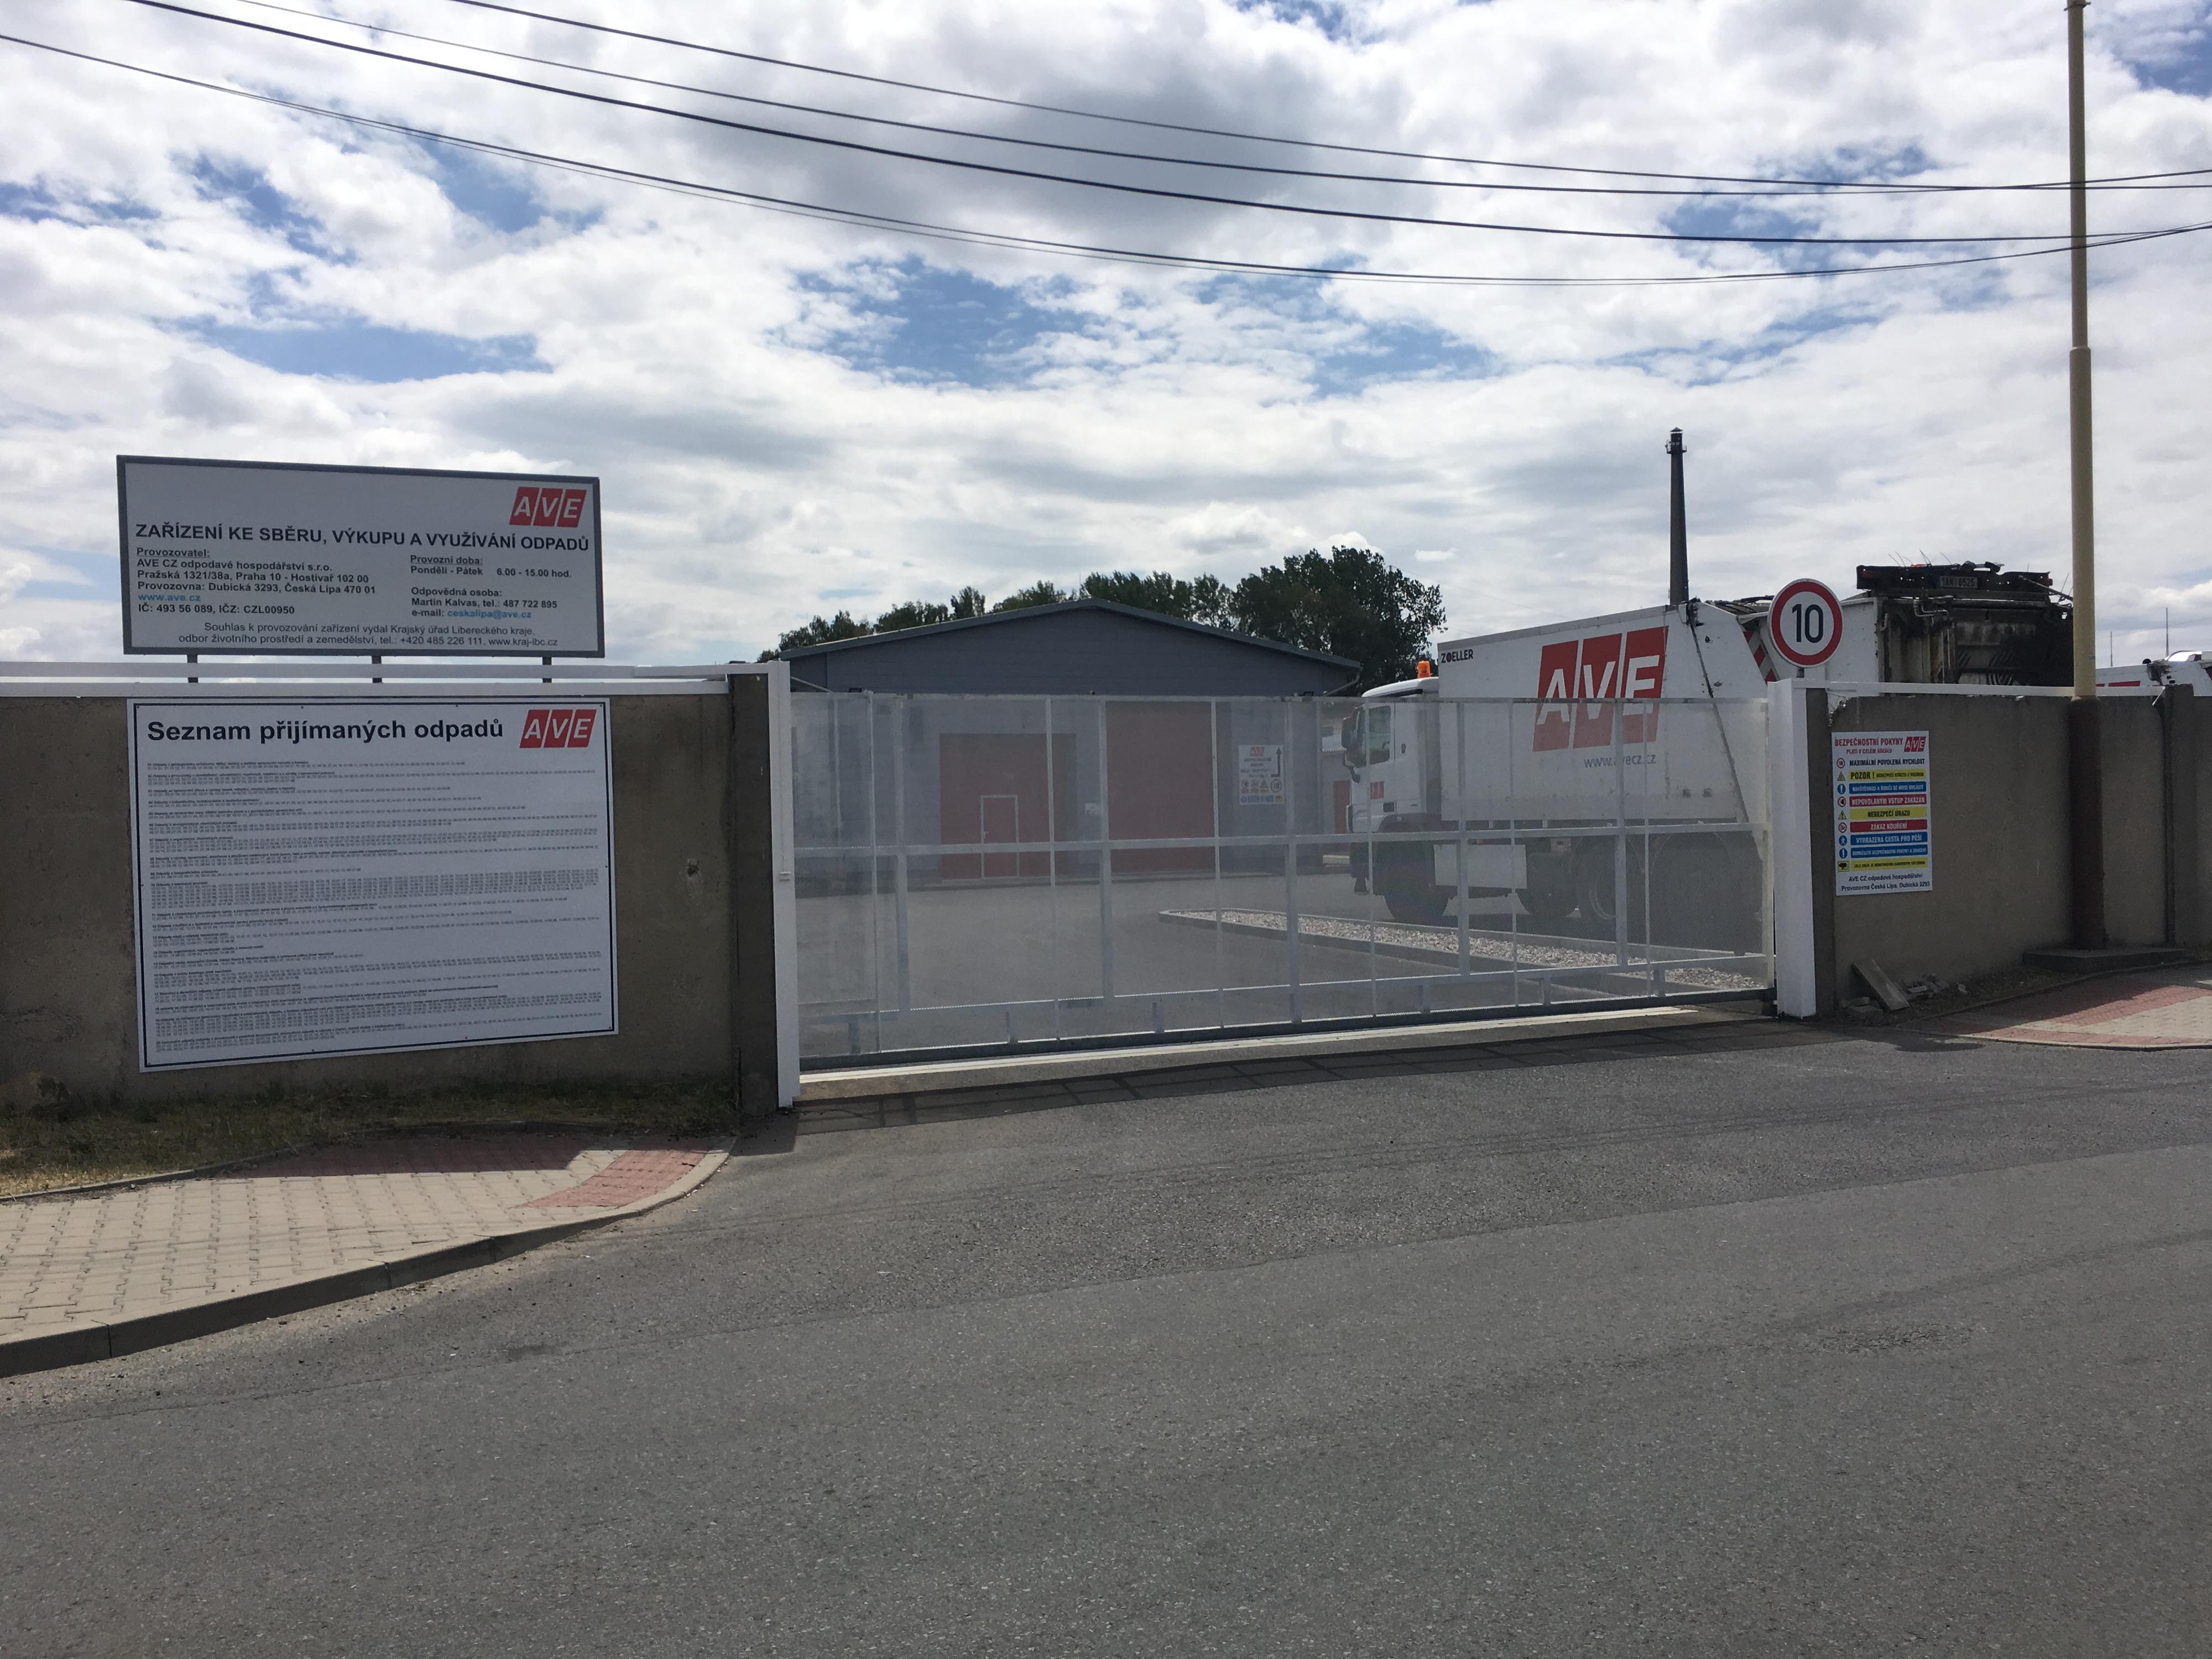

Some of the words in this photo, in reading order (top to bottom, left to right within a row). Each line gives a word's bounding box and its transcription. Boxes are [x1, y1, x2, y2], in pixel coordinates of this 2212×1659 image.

[514, 496, 581, 518] AVE
[135, 521, 222, 539] ZAŘÍZENÍ
[228, 526, 253, 540] KE
[259, 525, 326, 544] SBĚRU,
[332, 528, 404, 545] VÝKUPU
[410, 533, 422, 545] A
[426, 531, 515, 548] VYUŽÍVÁNÍ
[520, 535, 588, 550] ODPADŮ
[137, 547, 209, 558] Provozovatel:
[137, 558, 159, 567] AVE
[163, 559, 177, 567] CZ
[456, 556, 482, 565] doba:
[137, 570, 179, 578] Pražská
[183, 570, 232, 581] 1321/38a,
[236, 572, 265, 580] Praha
[269, 572, 281, 581] 10
[291, 573, 333, 582] Hostivař
[337, 574, 353, 582] 102
[456, 566, 483, 575] Pátek
[497, 567, 515, 576] 6.00
[525, 568, 549, 577] 15.00
[551, 569, 571, 577] hod.
[138, 581, 204, 590] Provozovna:
[208, 582, 251, 591] Dubická
[254, 583, 281, 593] 3293,
[284, 582, 316, 592] Česká
[343, 585, 361, 593] 470
[411, 586, 467, 596] Odpovědná
[138, 602, 152, 612] IČ:
[156, 604, 175, 612] 493
[179, 604, 191, 613] 56
[194, 604, 215, 614] 089,
[219, 603, 239, 613] IČZ:
[243, 605, 294, 614] CZL00950
[411, 597, 441, 606] Martin
[445, 598, 479, 607] Kalvas,
[522, 599, 538, 608] 722
[447, 609, 531, 618] ceskalipa@ave.cz
[205, 622, 245, 631] Souhlas
[248, 623, 254, 631] k
[257, 623, 317, 635] provozování
[362, 624, 387, 634] vydal
[390, 625, 425, 635] Krajský
[452, 625, 508, 635] Libereckého
[1792, 603, 1824, 644] 10
[179, 634, 208, 642] odbor
[380, 636, 397, 645] tel.:
[400, 636, 424, 644] +420
[426, 636, 444, 644] 485
[488, 638, 557, 647] www.kraj-lbc.cz
[1441, 649, 1474, 664] ZOELLER
[1536, 655, 1660, 725] AVE
[147, 721, 250, 740] Seznam
[260, 719, 405, 744] přijímaných
[414, 718, 502, 742] odpadů
[524, 718, 591, 739] AVE
[1834, 737, 1879, 747] BEZPEČNOSTNÍ
[1881, 737, 1903, 746] POKYNY
[1905, 739, 1924, 749] AVE
[1849, 758, 1876, 766] MAXIMÁLNÍ
[1877, 758, 1902, 766] POVOLENÁ
[1850, 771, 1871, 780] POZOR
